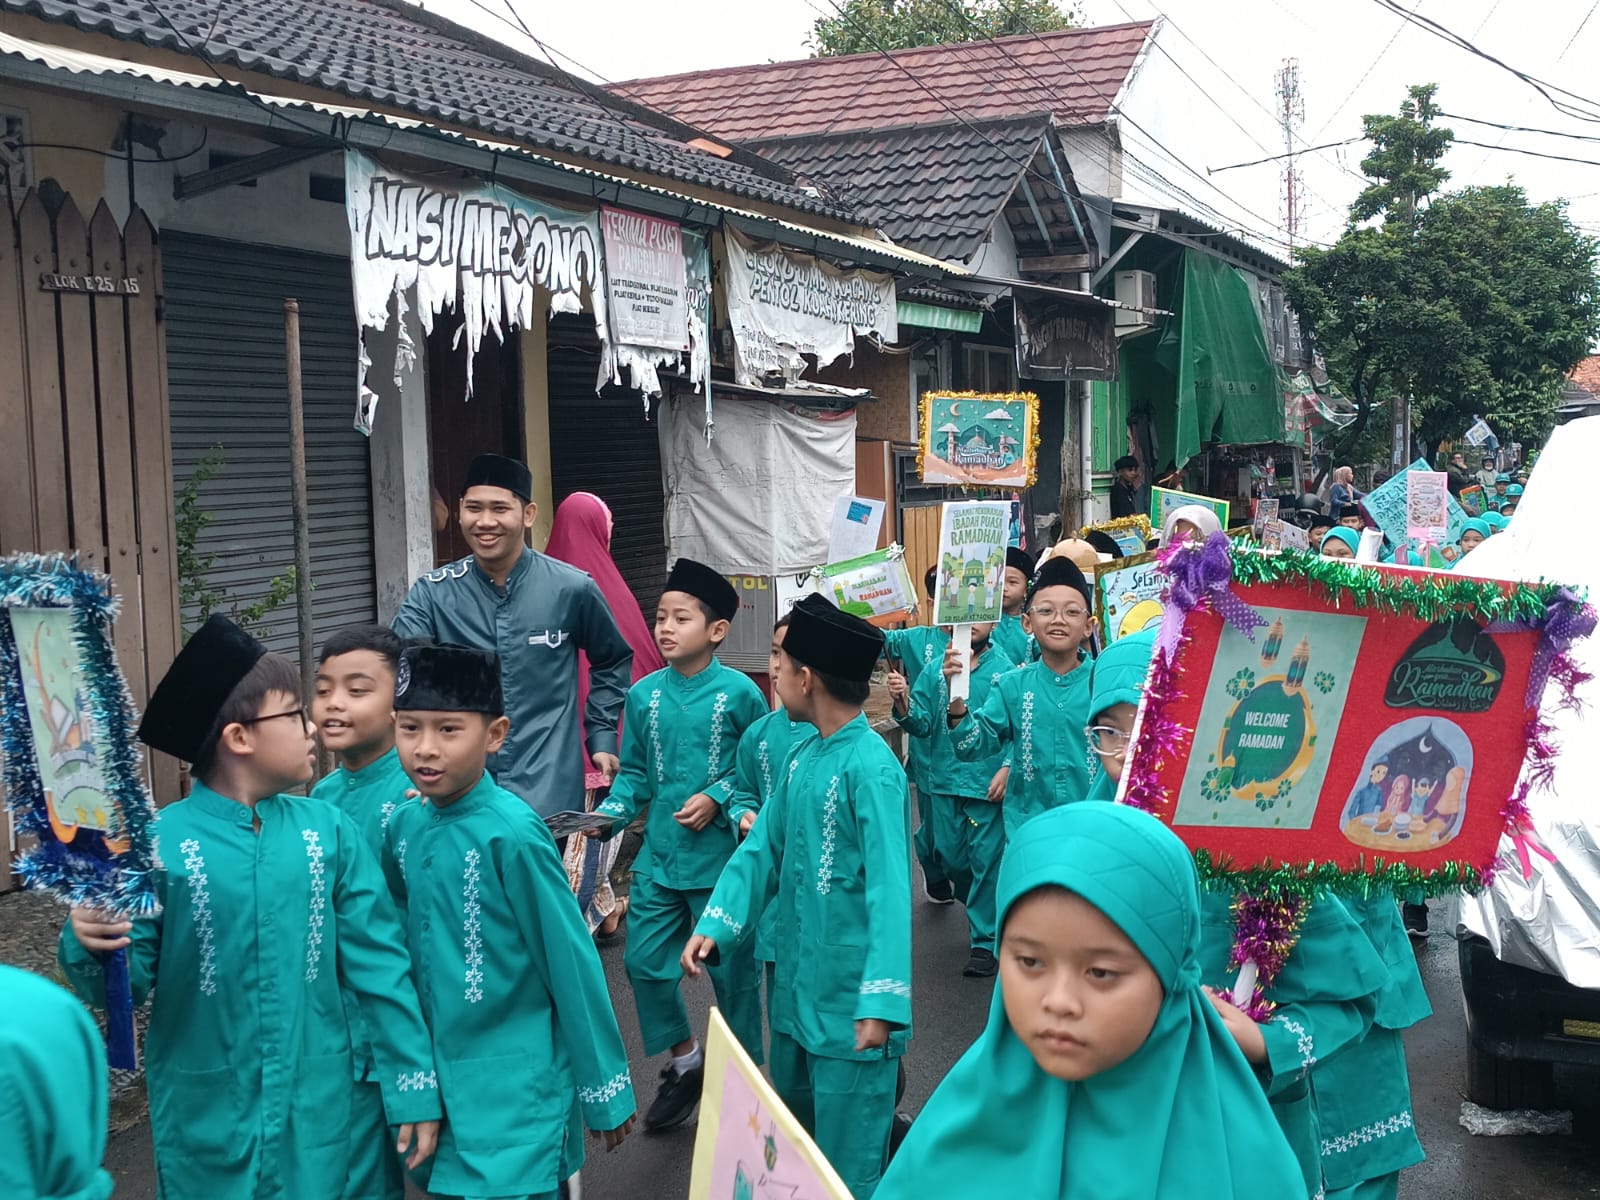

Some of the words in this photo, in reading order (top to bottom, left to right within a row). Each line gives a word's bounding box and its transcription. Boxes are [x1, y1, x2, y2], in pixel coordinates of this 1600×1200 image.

[365, 177, 458, 267] NASI
[603, 210, 647, 246] TERIMA
[750, 271, 801, 313] PENTOL
[954, 452, 1005, 467] Ramadhan
[952, 516, 979, 531] IBADAH
[980, 515, 1003, 530] PUASA
[951, 528, 1004, 547] RAMADHAN
[1386, 662, 1494, 706] Ramadhan
[1244, 711, 1291, 728] WELCOME
[1238, 732, 1285, 749] RAMADAN
